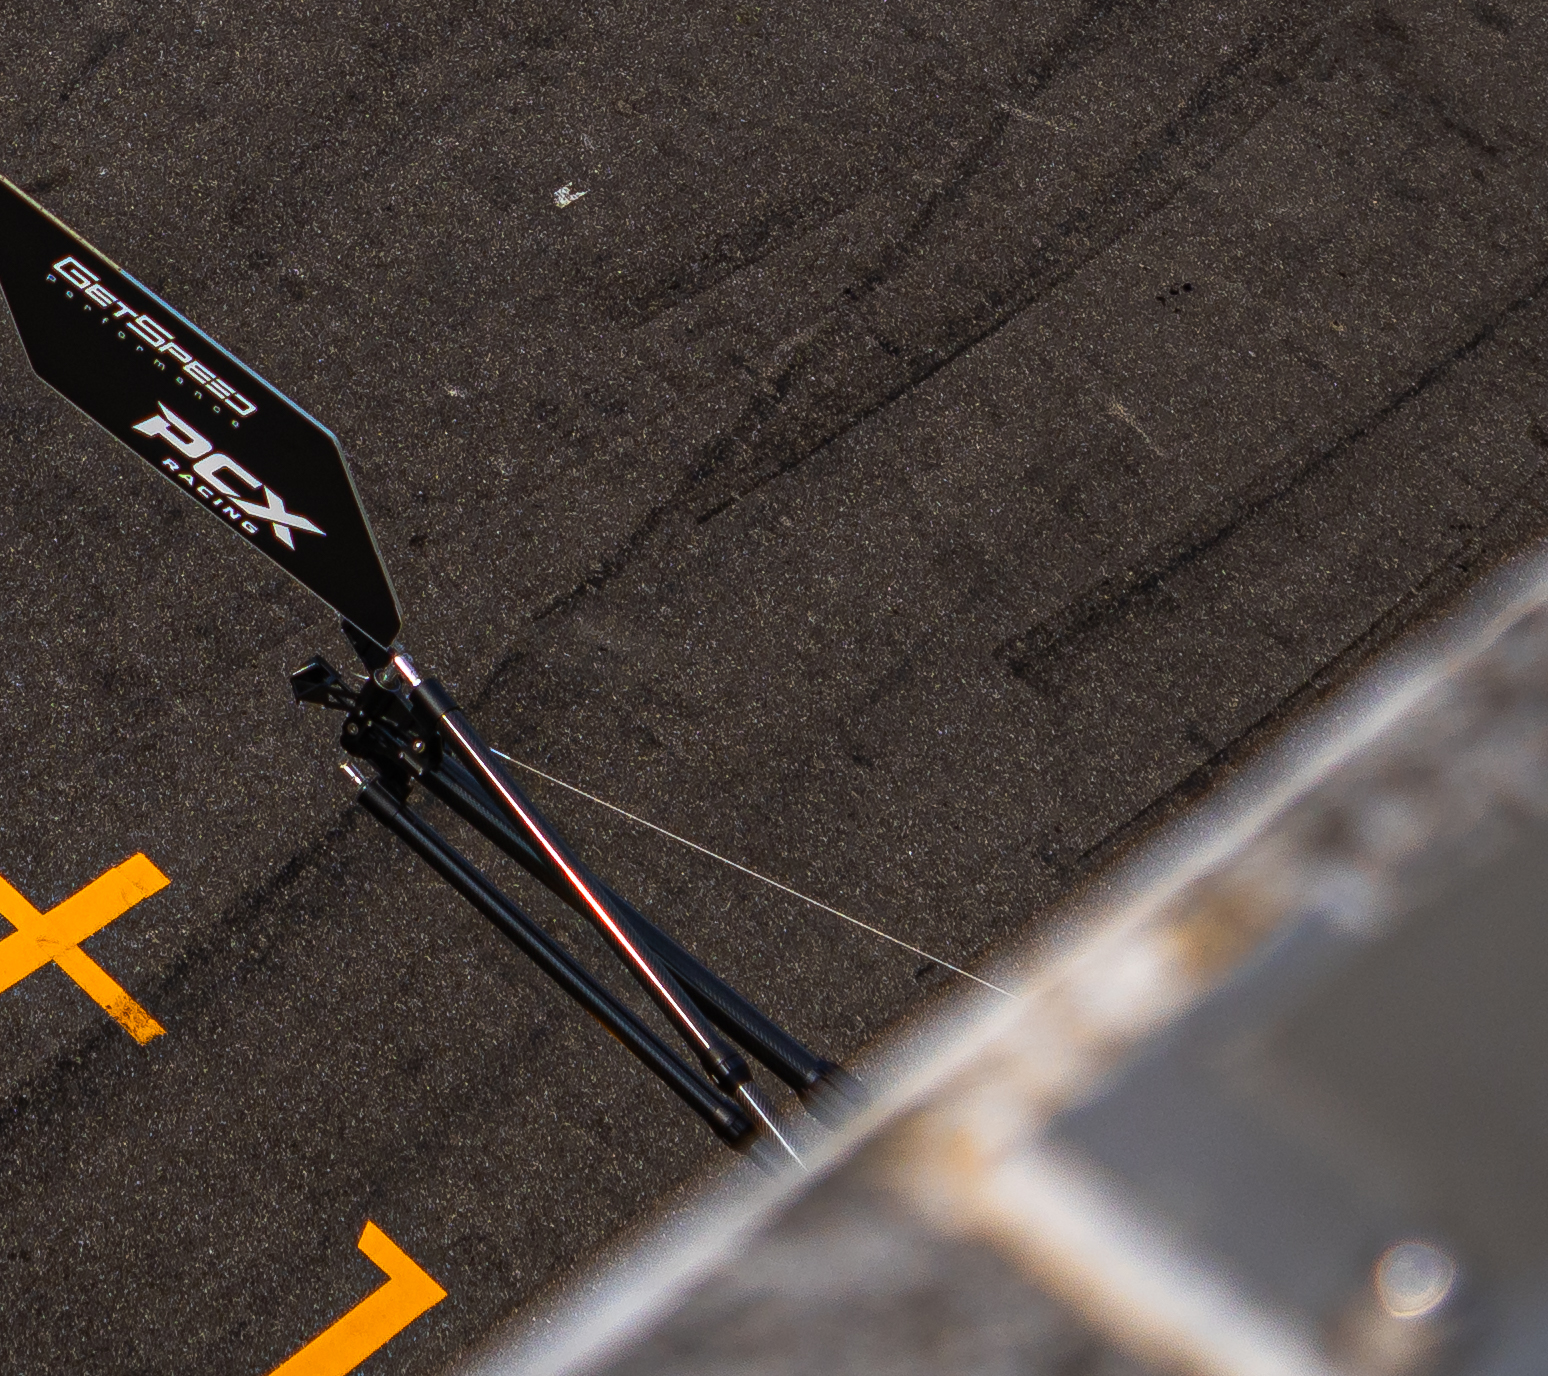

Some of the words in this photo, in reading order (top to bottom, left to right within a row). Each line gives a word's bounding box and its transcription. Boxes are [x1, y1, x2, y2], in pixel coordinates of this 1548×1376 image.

[53, 256, 257, 416] GETSPEED
[132, 401, 326, 550] PCX
[161, 456, 260, 536] RACING
